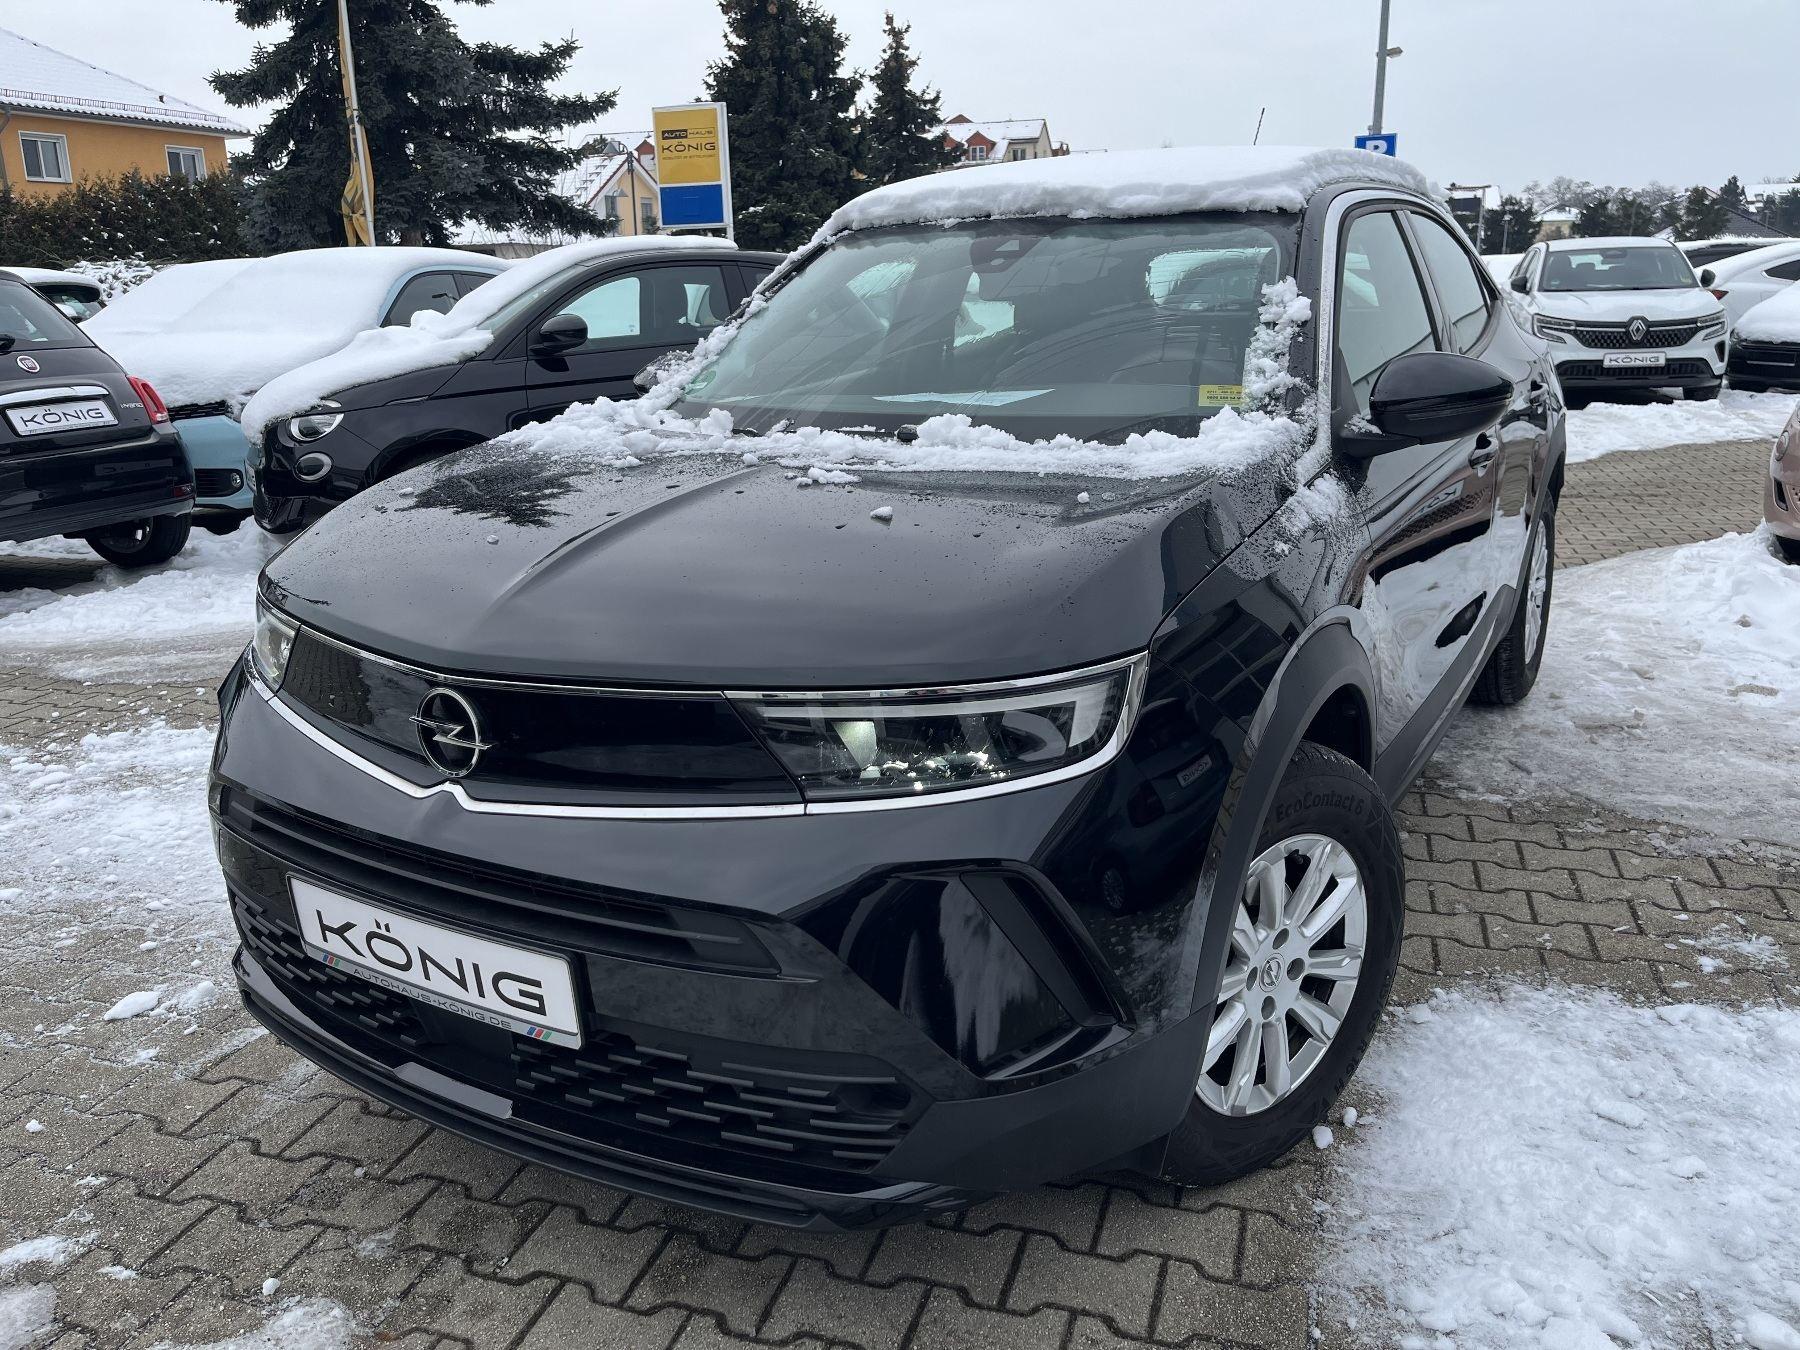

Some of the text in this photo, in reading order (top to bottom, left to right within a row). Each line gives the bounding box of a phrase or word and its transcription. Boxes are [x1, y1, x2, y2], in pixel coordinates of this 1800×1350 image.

[661, 141, 716, 153] KÖNIG
[1365, 139, 1388, 154] P
[1608, 354, 1660, 364] KÖNIG
[20, 408, 105, 428] KÖNIG
[1275, 790, 1365, 823] EcoContact 6
[316, 908, 548, 1017] KÖNIG
[352, 967, 513, 1031] AUTOHAUS-KÖNIG.DE
